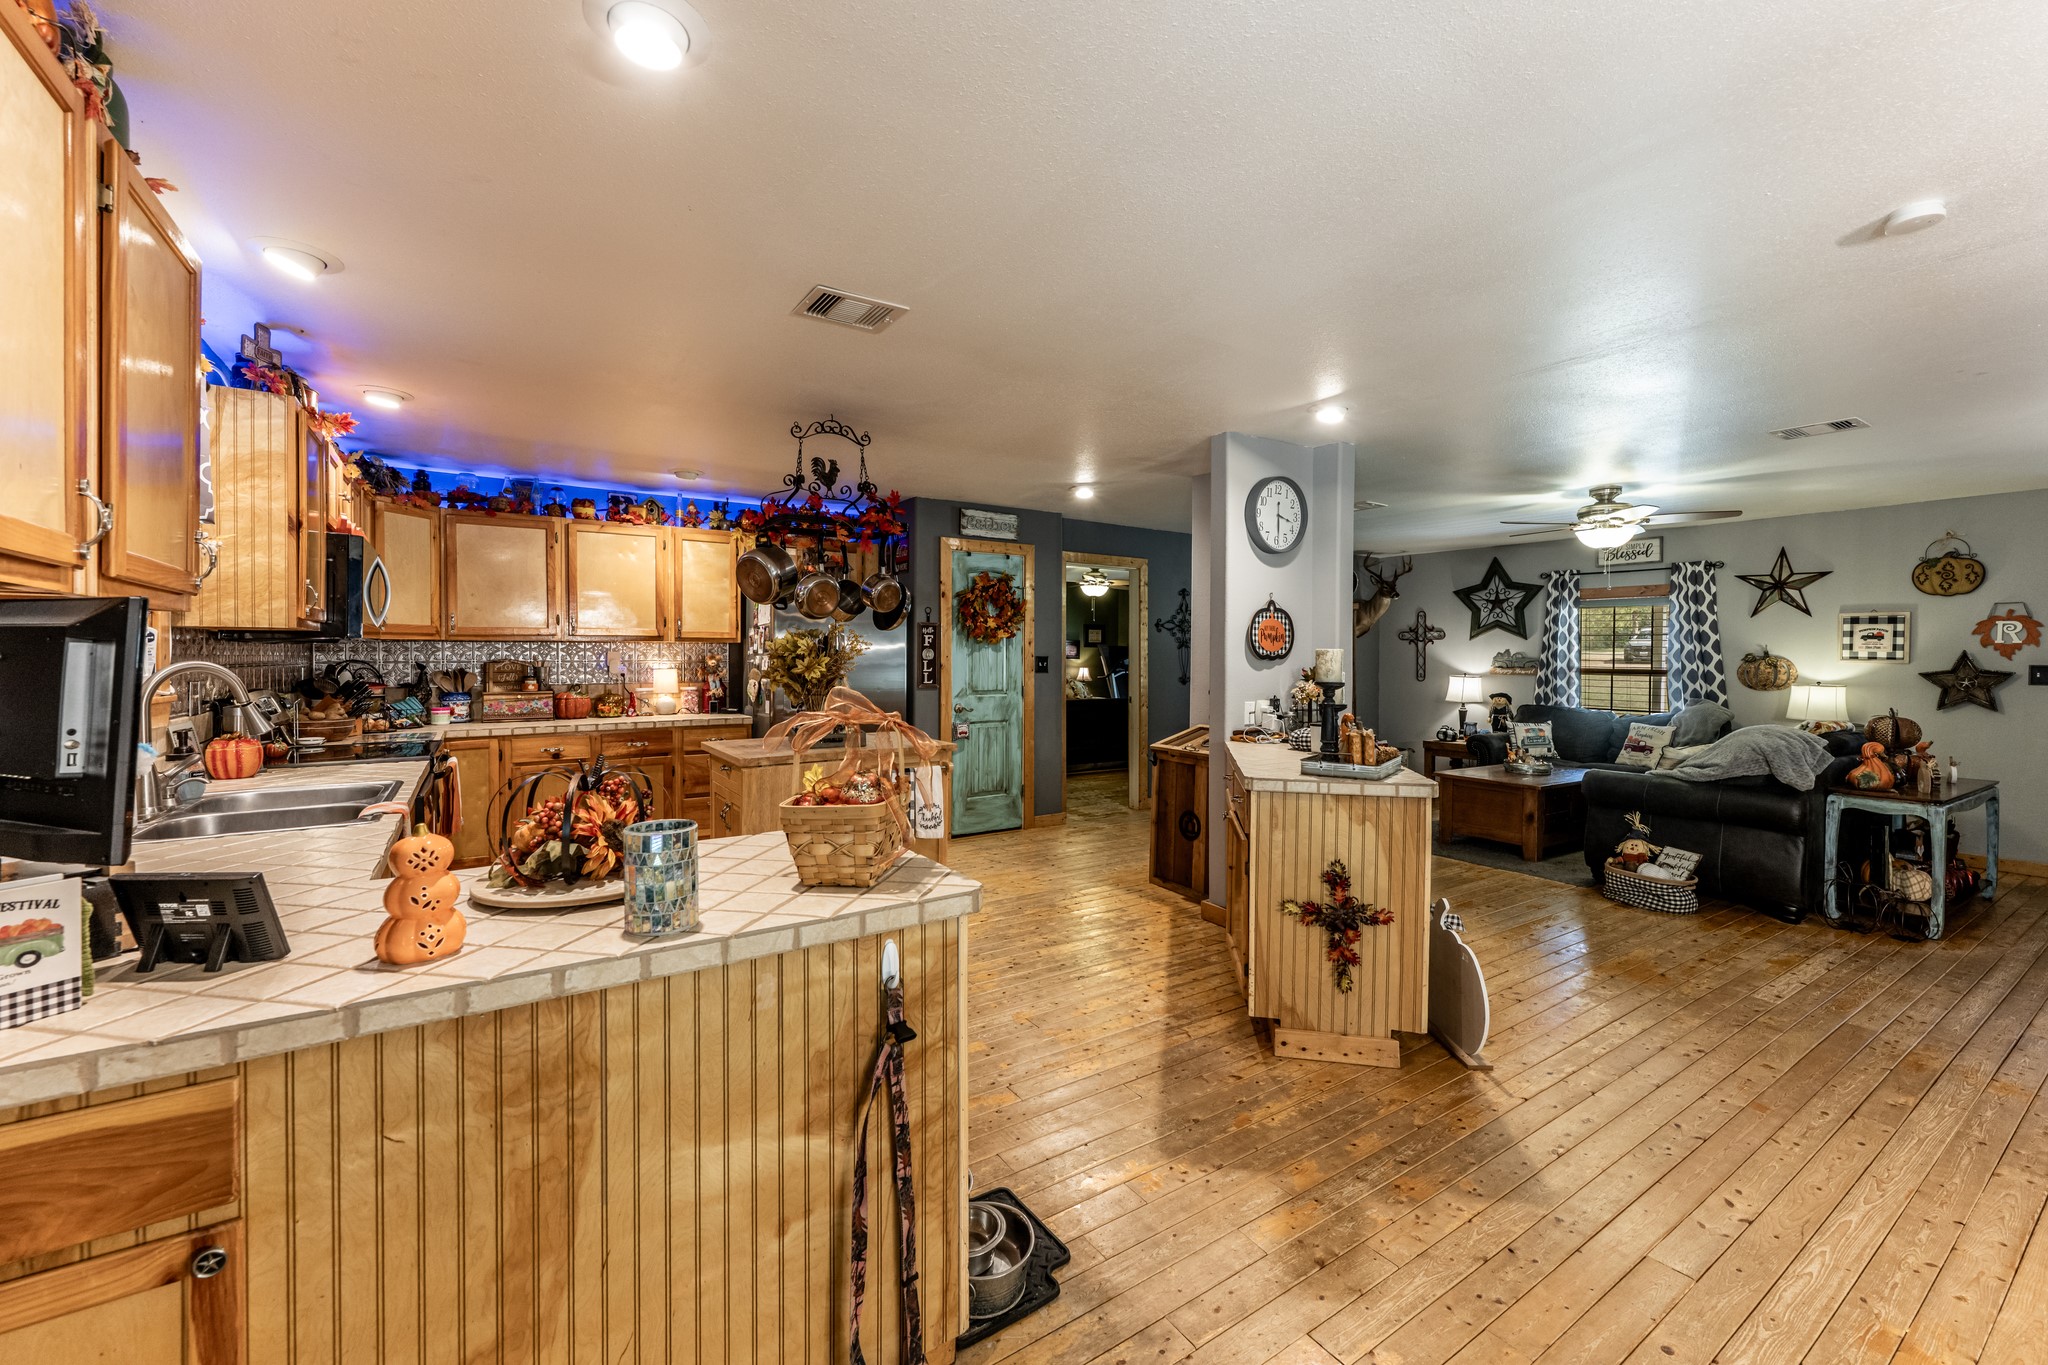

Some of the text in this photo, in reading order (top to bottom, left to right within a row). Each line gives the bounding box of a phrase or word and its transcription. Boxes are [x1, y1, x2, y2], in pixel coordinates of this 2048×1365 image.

[1606, 543, 1654, 561] Blessed
[1626, 542, 1646, 550] SIMPLY
[1995, 621, 2022, 643] R
[0, 899, 61, 912] ESTIVAL
